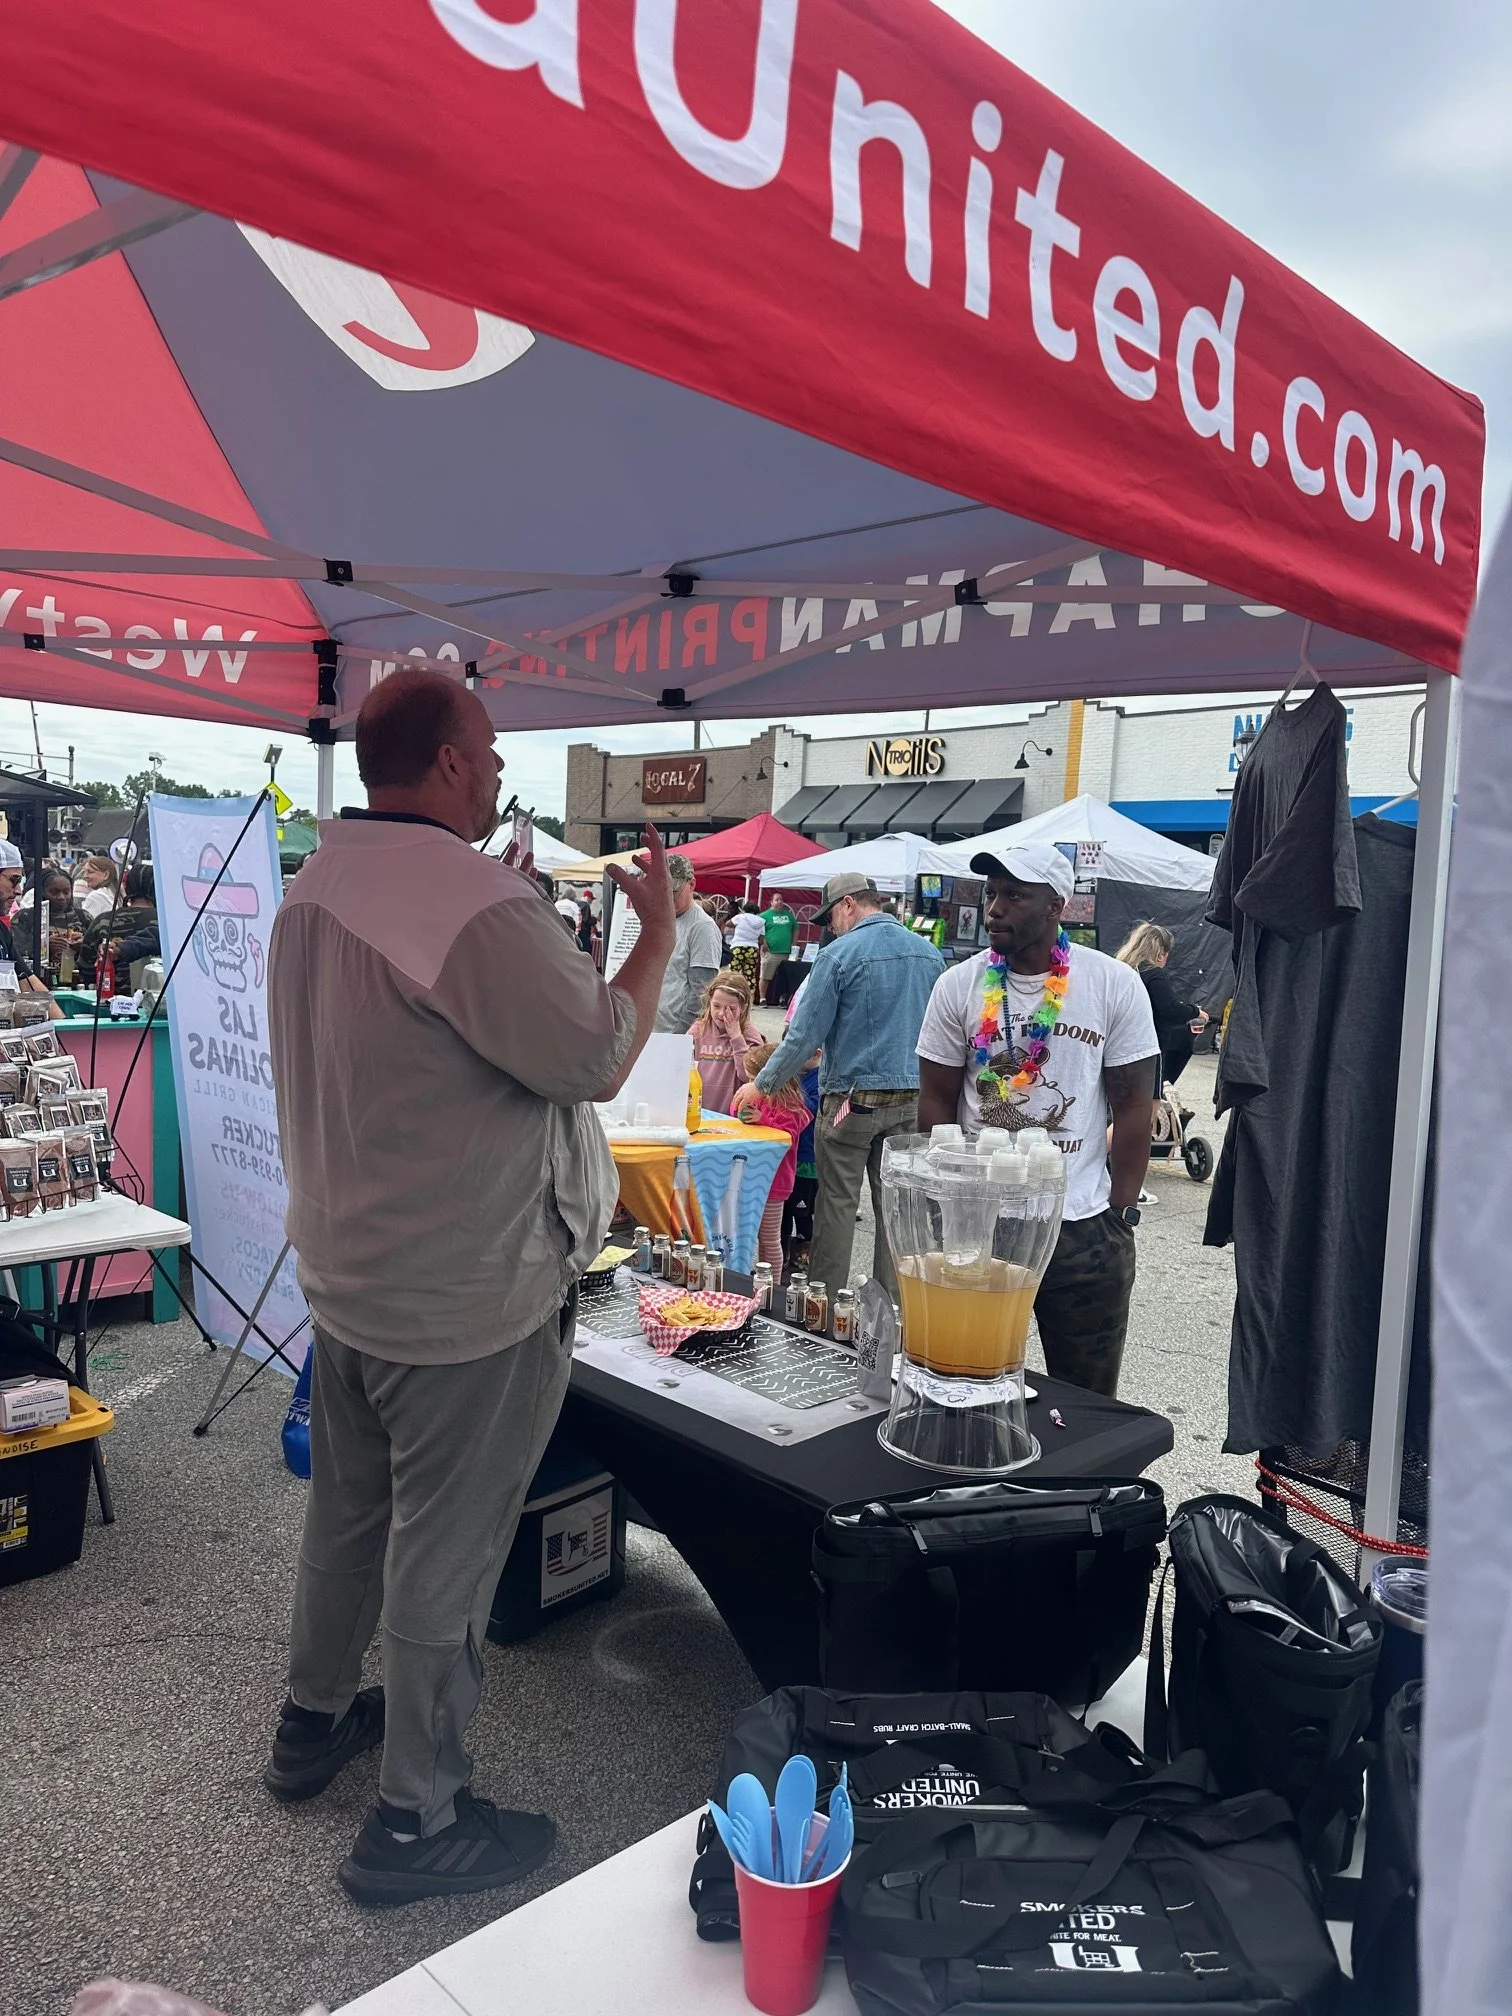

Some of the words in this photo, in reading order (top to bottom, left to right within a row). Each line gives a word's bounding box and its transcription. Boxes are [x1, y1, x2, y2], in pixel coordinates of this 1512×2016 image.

[889, 750, 912, 764] TRIO
[687, 763, 701, 792] 7
[1009, 1012, 1026, 1023] The
[1053, 1022, 1105, 1048] DOIN'
[1051, 1138, 1083, 1154] UAT
[873, 1725, 894, 1733] RUBS
[896, 1723, 919, 1732] CRAFT
[901, 1778, 981, 1796] UNITED
[1020, 1901, 1146, 1915] SMKERS
[1058, 1913, 1116, 1930] TED
[1050, 1932, 1071, 1940] NITE
[1073, 1932, 1091, 1940] FOR
[1093, 1933, 1122, 1942] MEAT.
